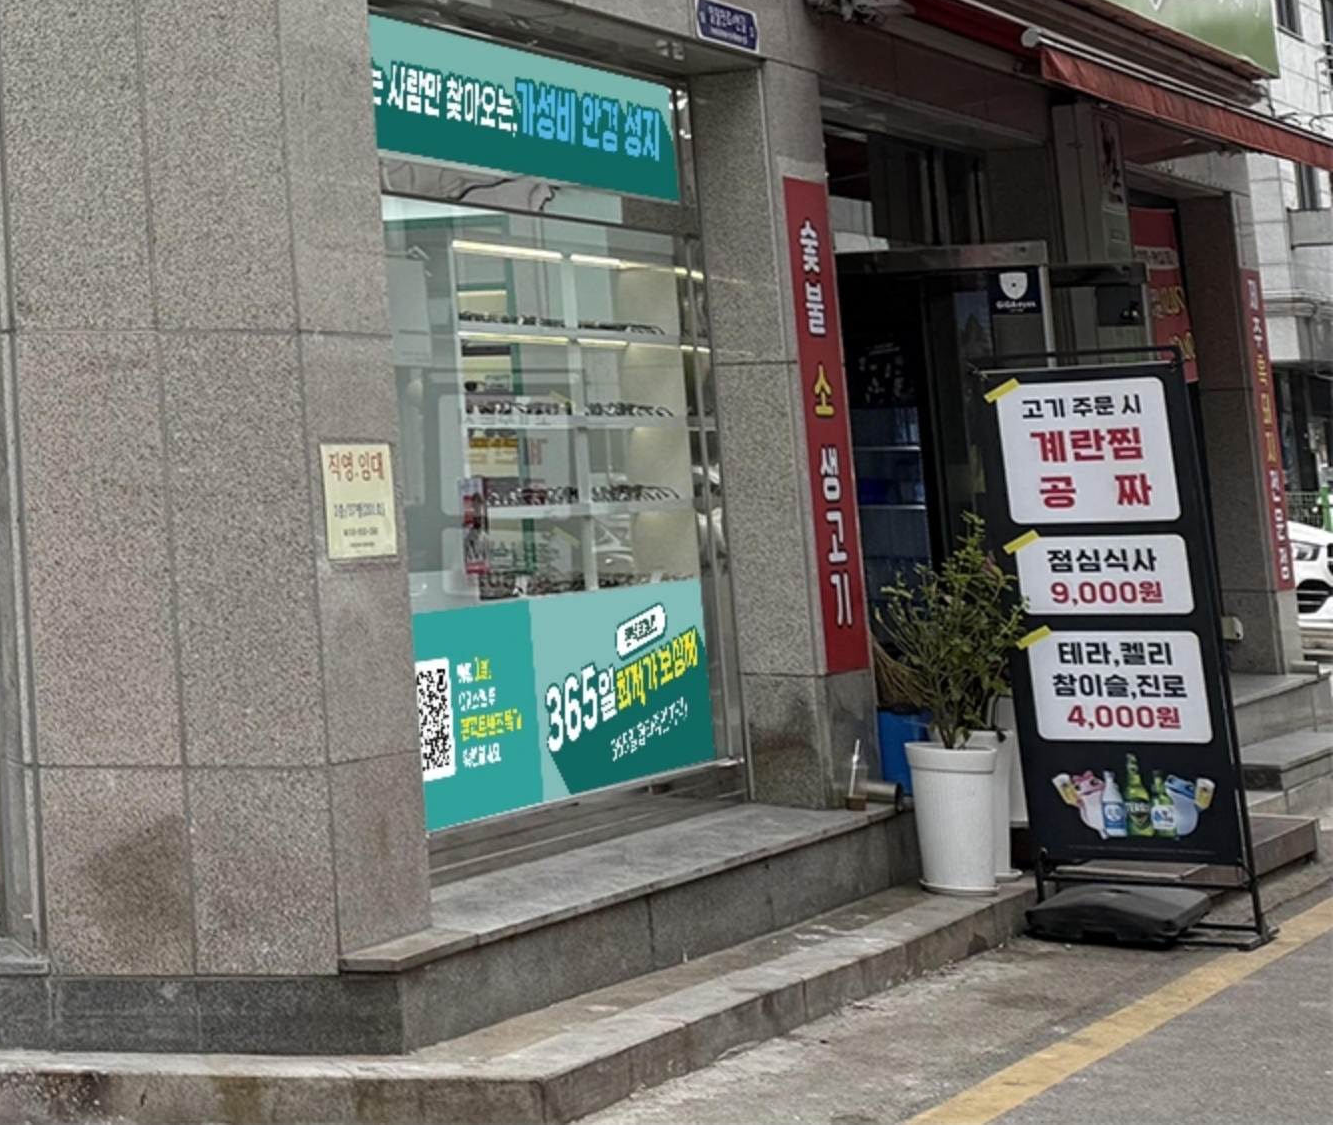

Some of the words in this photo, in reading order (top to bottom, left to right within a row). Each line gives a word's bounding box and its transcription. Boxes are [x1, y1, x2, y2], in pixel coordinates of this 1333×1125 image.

[387, 65, 442, 117] 사람만
[517, 82, 575, 145] 가성비
[583, 97, 618, 153] 안경
[625, 106, 660, 162] 성지
[814, 364, 835, 418] 소
[1022, 400, 1066, 420] 고기
[1073, 396, 1115, 418] 주문
[1122, 394, 1142, 415] 시
[1030, 428, 1144, 465] 계란찜
[1040, 475, 1077, 509] 공
[1116, 472, 1152, 506] 짜
[1047, 547, 1157, 573] 점심식사
[1050, 581, 1164, 606] 9,000원
[1058, 641, 1173, 668] 테라,켈리
[1052, 673, 1187, 700] 참이슬,진로
[1067, 705, 1182, 731] 4,000원
